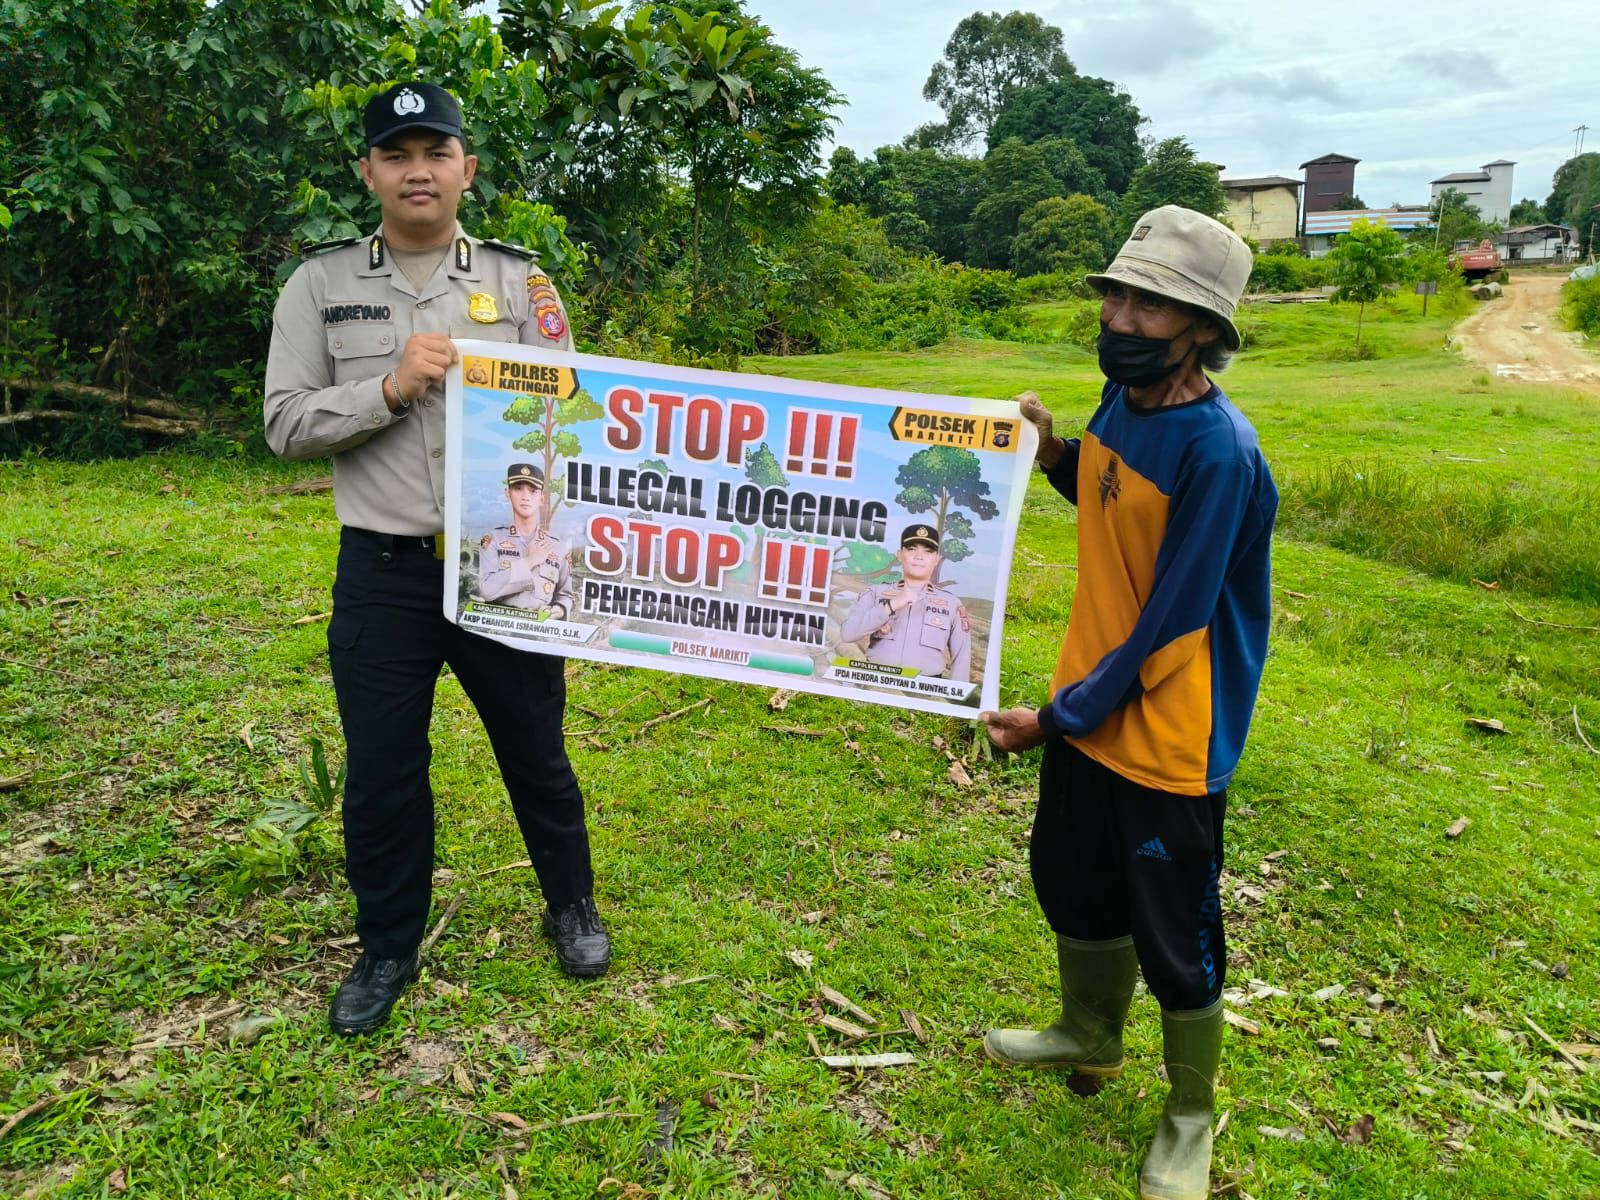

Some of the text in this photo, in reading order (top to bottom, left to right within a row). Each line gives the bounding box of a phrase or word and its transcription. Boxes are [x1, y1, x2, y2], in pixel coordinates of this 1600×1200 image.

[500, 362, 559, 382] POLRES
[498, 378, 559, 396] KATINGAN
[607, 389, 858, 478] STOP !!!
[904, 412, 976, 434] POLSEK
[904, 429, 974, 445] MARIKIT
[565, 461, 888, 542] ILLEGAL LOGGING
[589, 517, 828, 603] STOP !!!
[463, 614, 480, 623] AKBP
[481, 616, 514, 630] CHANDRA
[584, 581, 825, 645] PENEBANGAN HUTAN
[926, 606, 949, 616] POLRI
[672, 641, 749, 664] POLSEK MARIKIT
[835, 668, 965, 697] IPDA HENDRA SOPIYAN D. MUNTHE, S.H.
